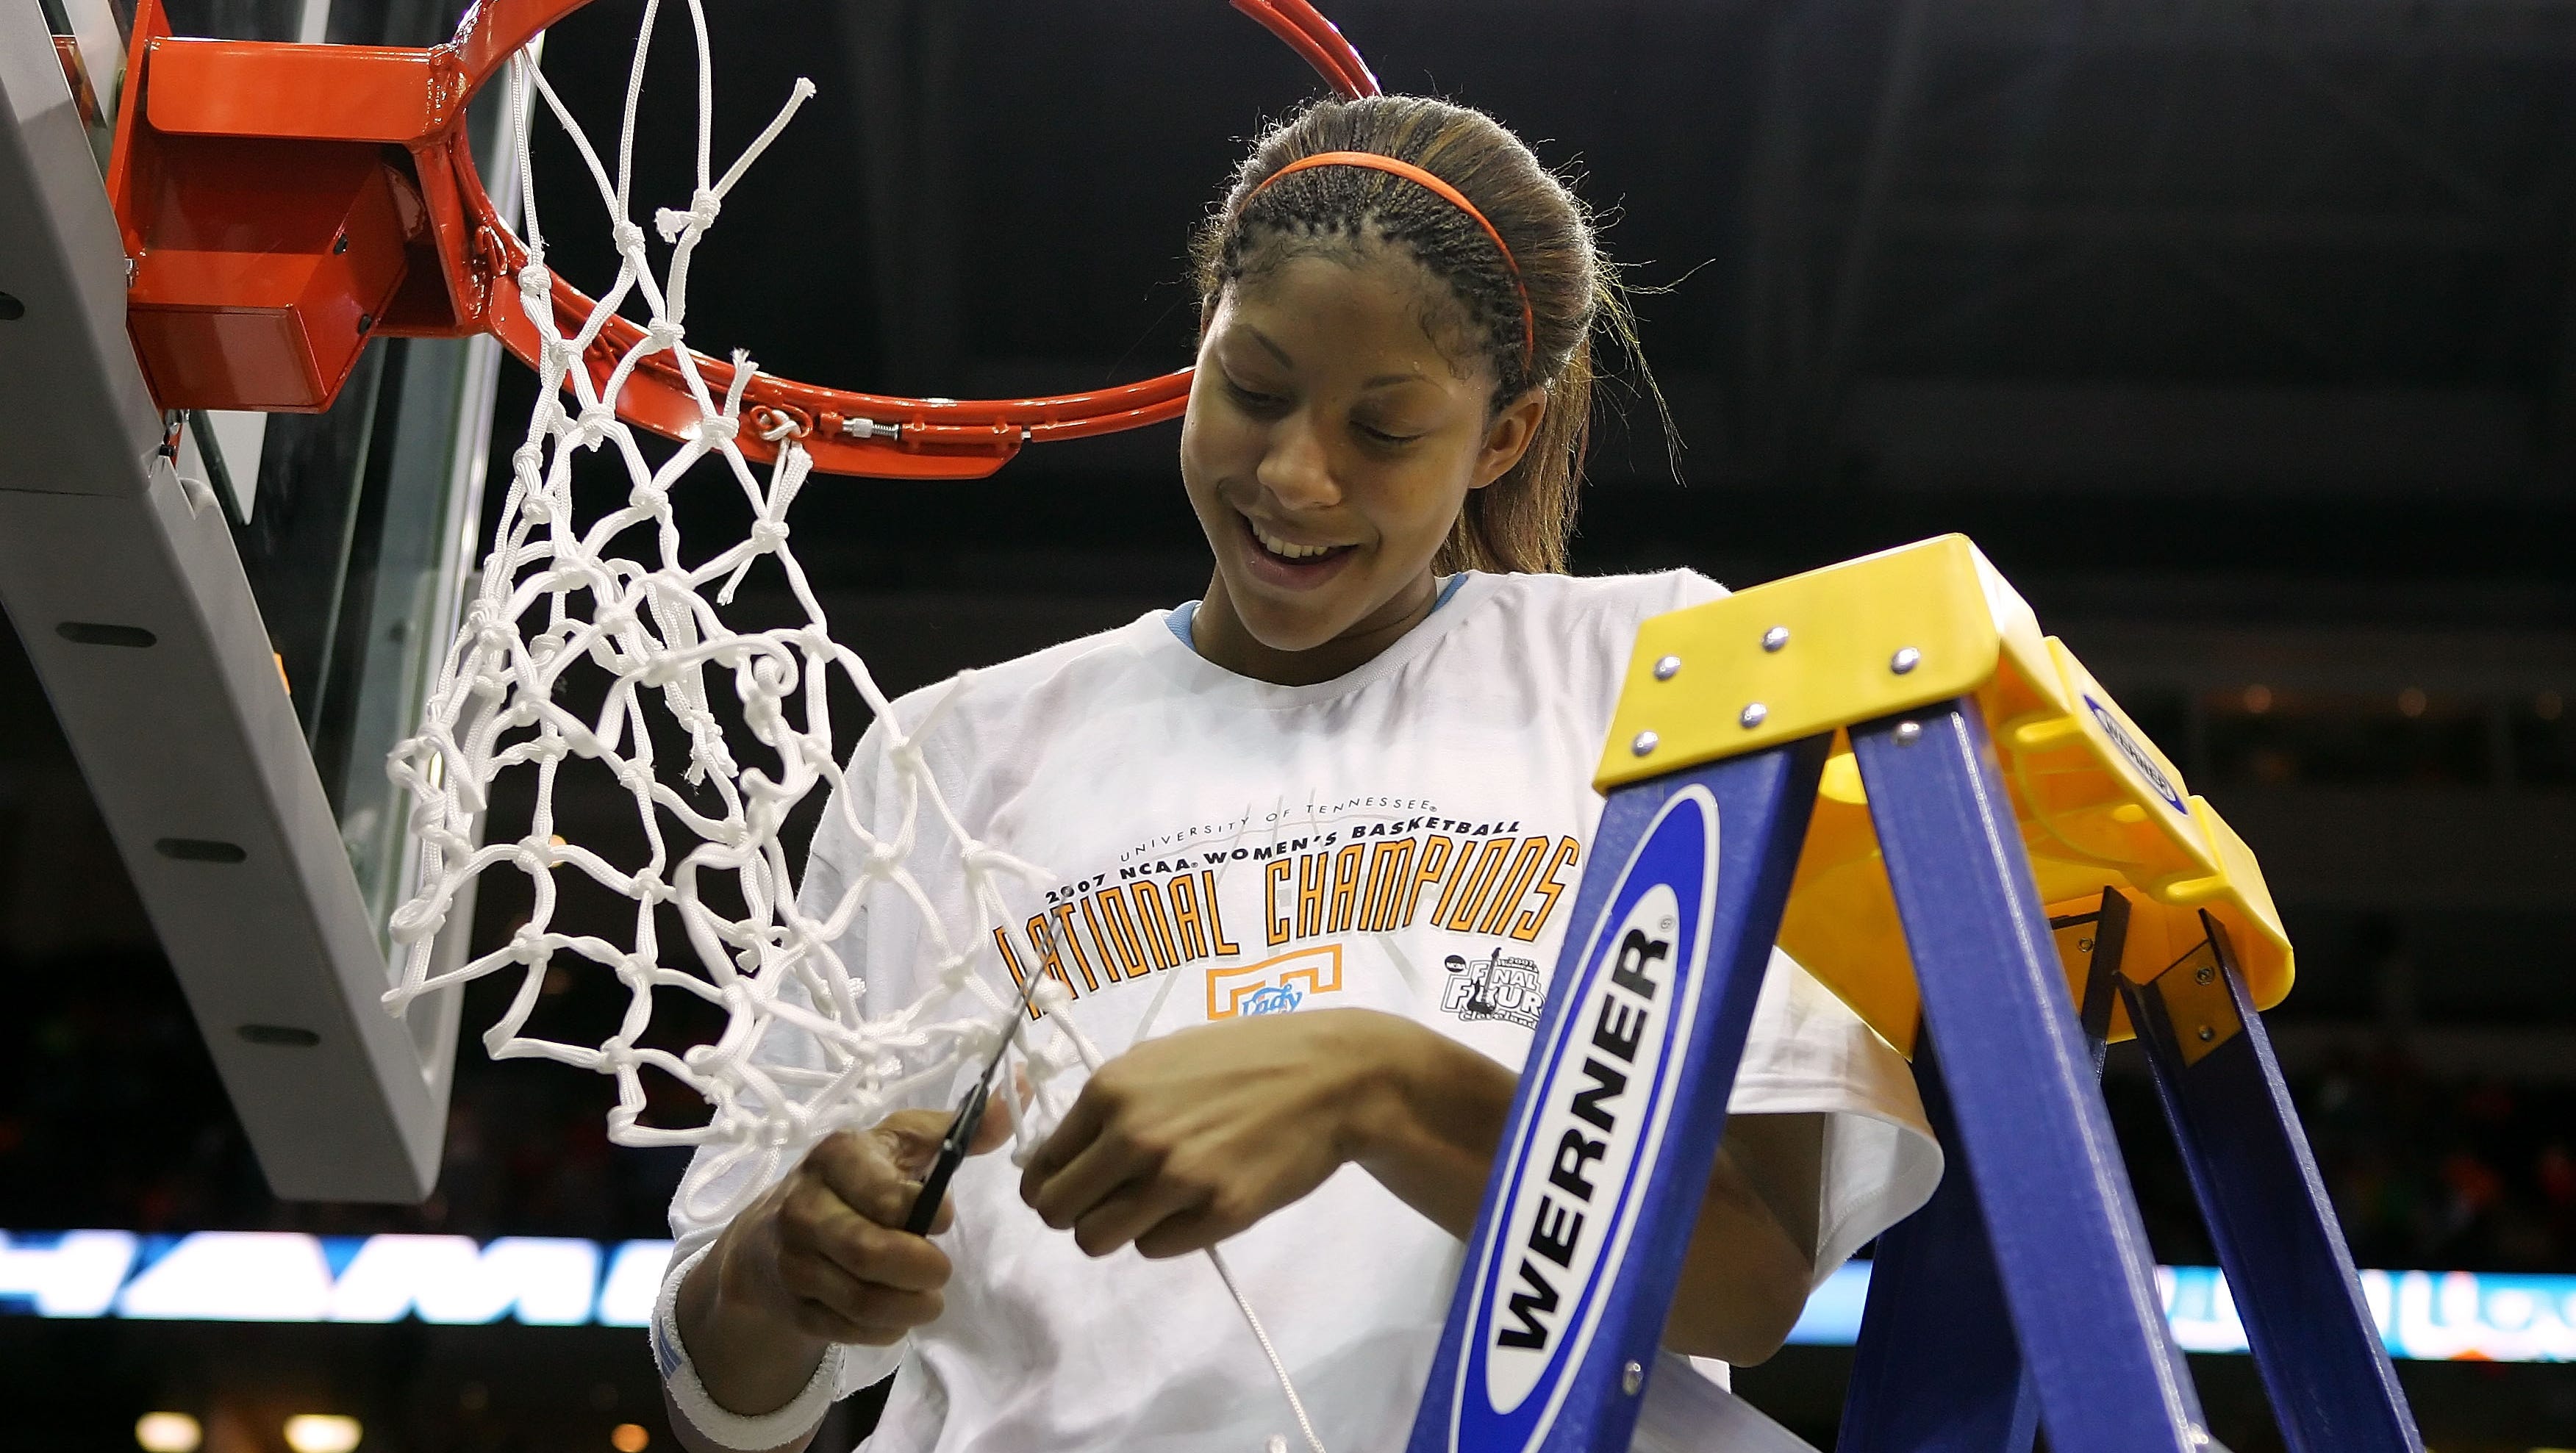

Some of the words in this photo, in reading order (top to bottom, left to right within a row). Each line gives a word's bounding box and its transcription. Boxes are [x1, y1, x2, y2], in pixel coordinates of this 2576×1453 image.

[1045, 872, 1106, 905] 2007
[1203, 831, 1338, 864] WOMEN'S
[1351, 816, 1521, 838] BASKETBALL
[1120, 817, 1250, 862] UNIVERSITY
[1265, 808, 1291, 822] OF
[1305, 796, 1431, 814] TENNESSEE
[1264, 833, 1580, 947] CHAMPIONS
[1497, 928, 1672, 1353] WERNER
